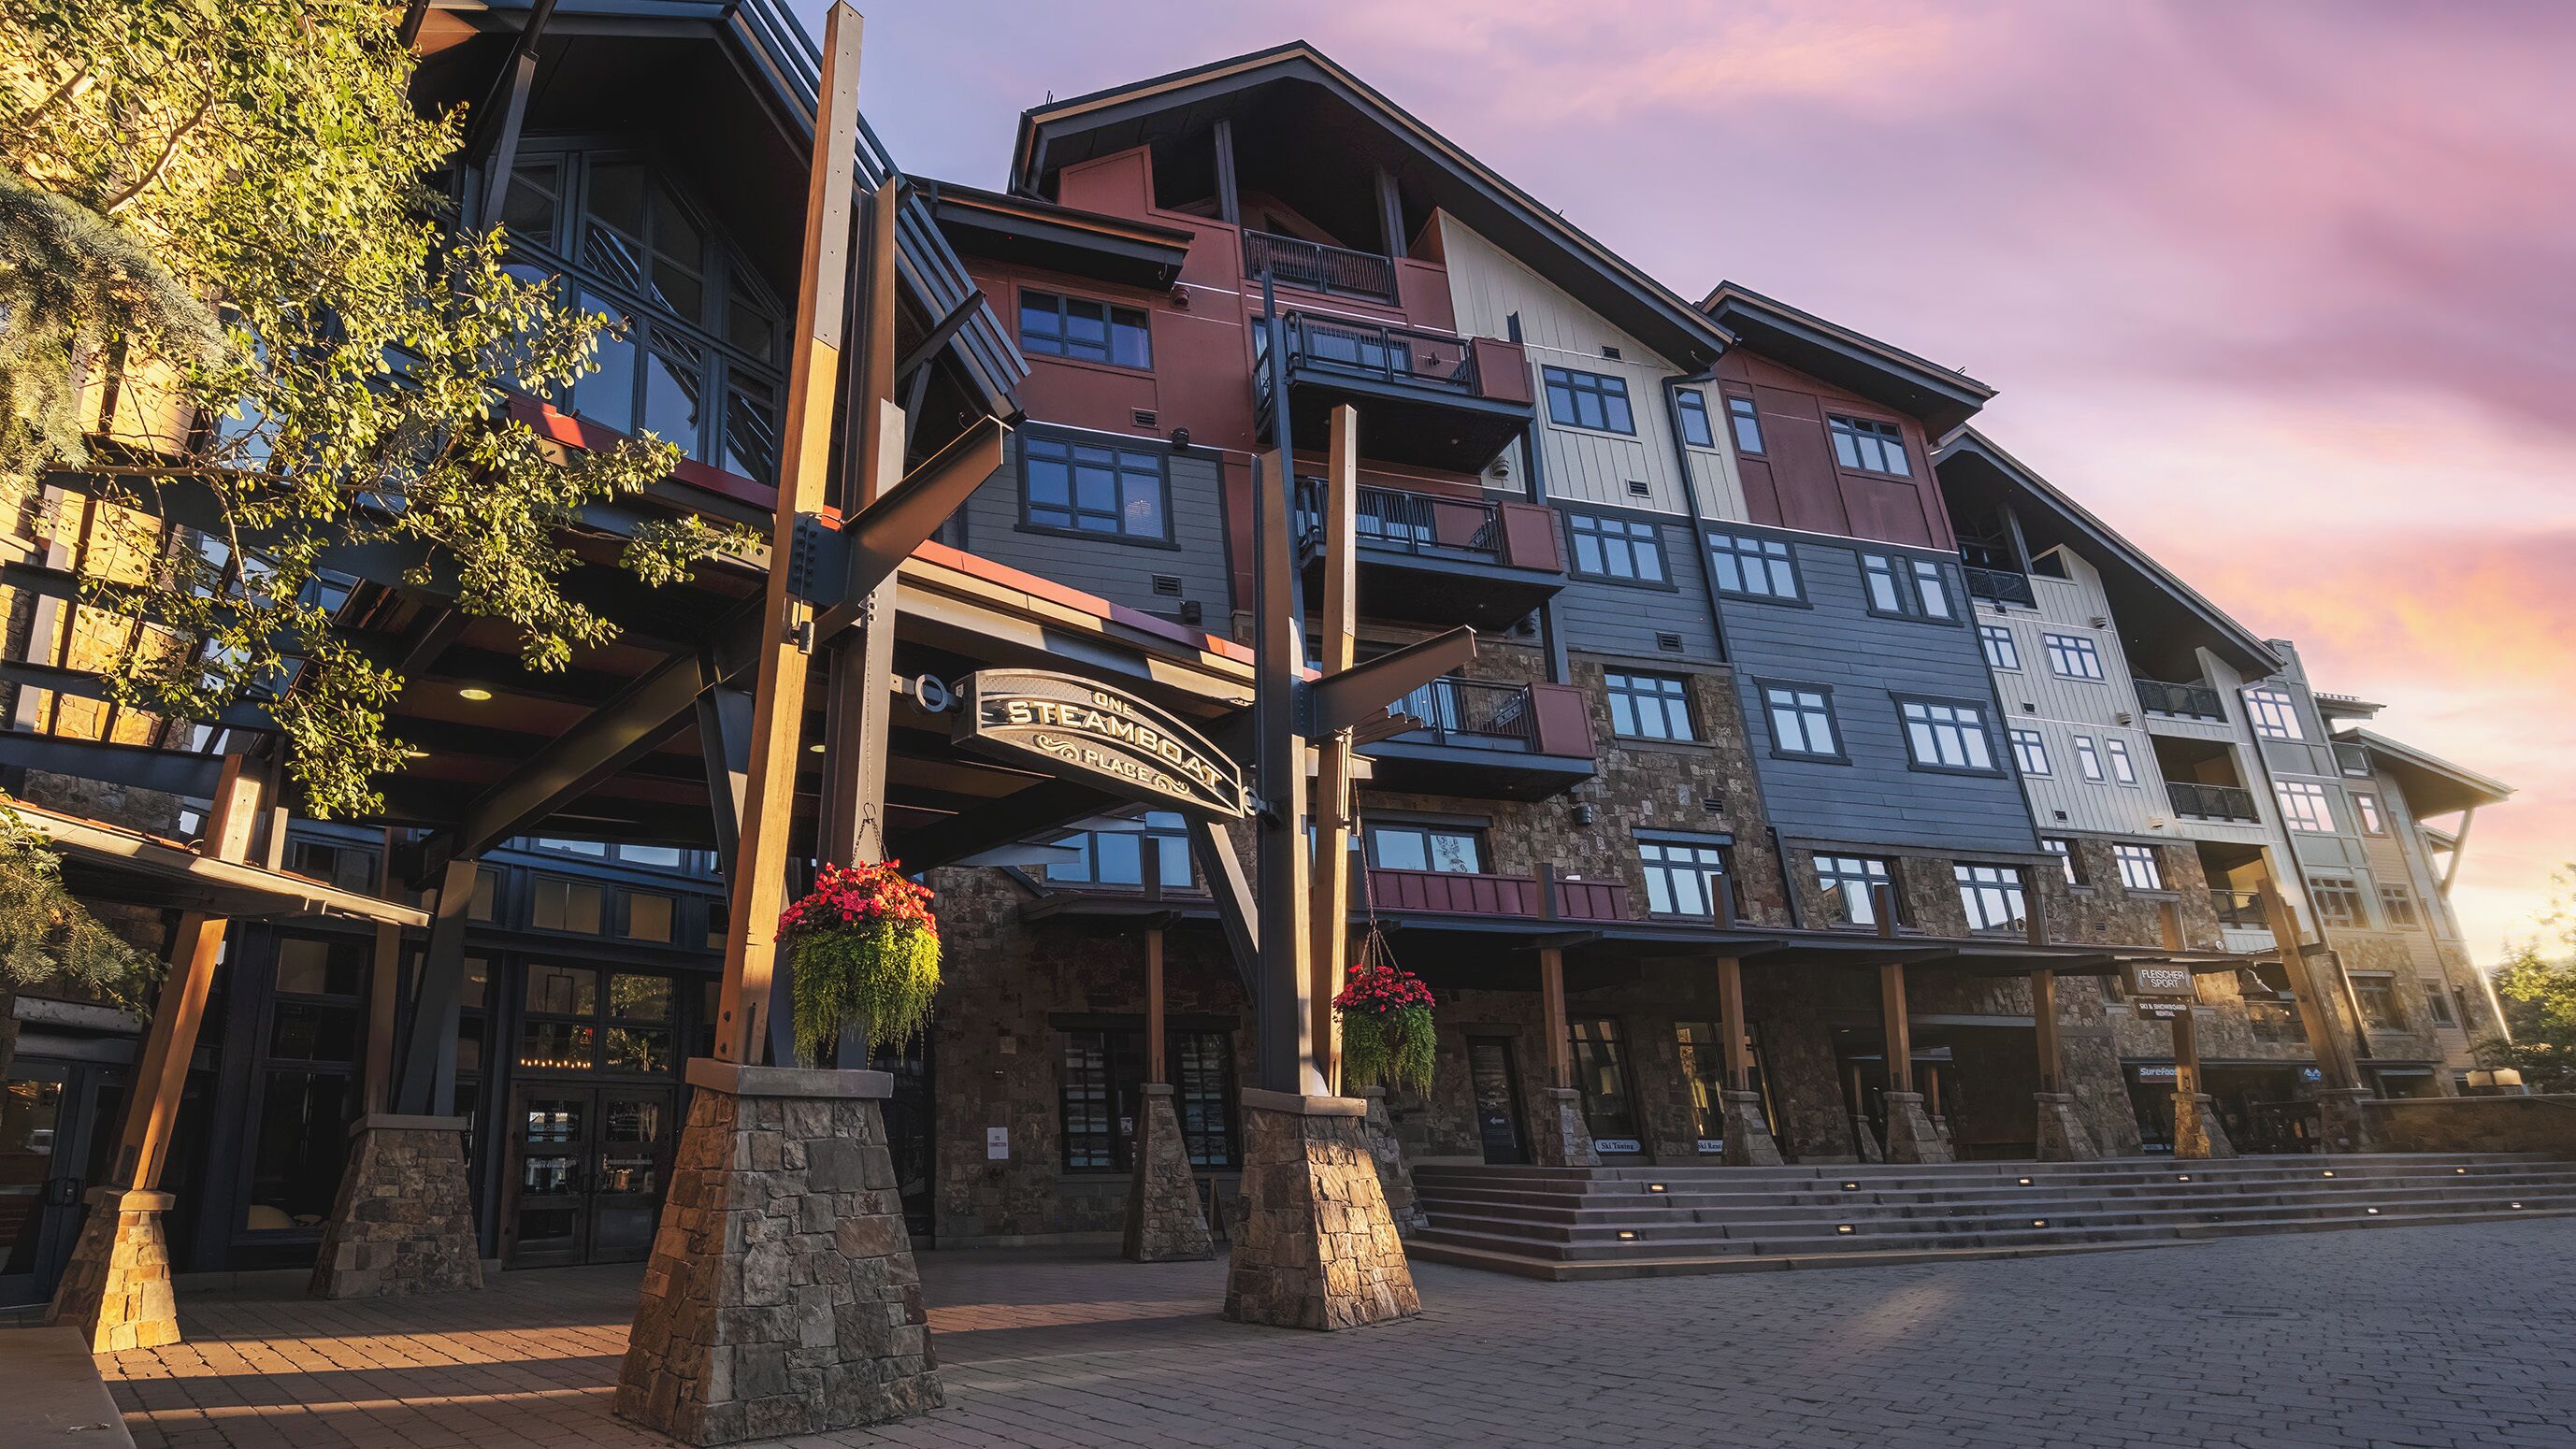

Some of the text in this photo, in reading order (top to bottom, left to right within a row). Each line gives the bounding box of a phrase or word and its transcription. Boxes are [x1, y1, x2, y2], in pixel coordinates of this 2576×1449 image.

[1092, 692, 1135, 717] ONE
[1007, 701, 1223, 788] STEAMBOAT
[1085, 749, 1150, 782] PLACE
[2141, 969, 2184, 979] FLEISCHER
[2151, 979, 2178, 987] SPORT
